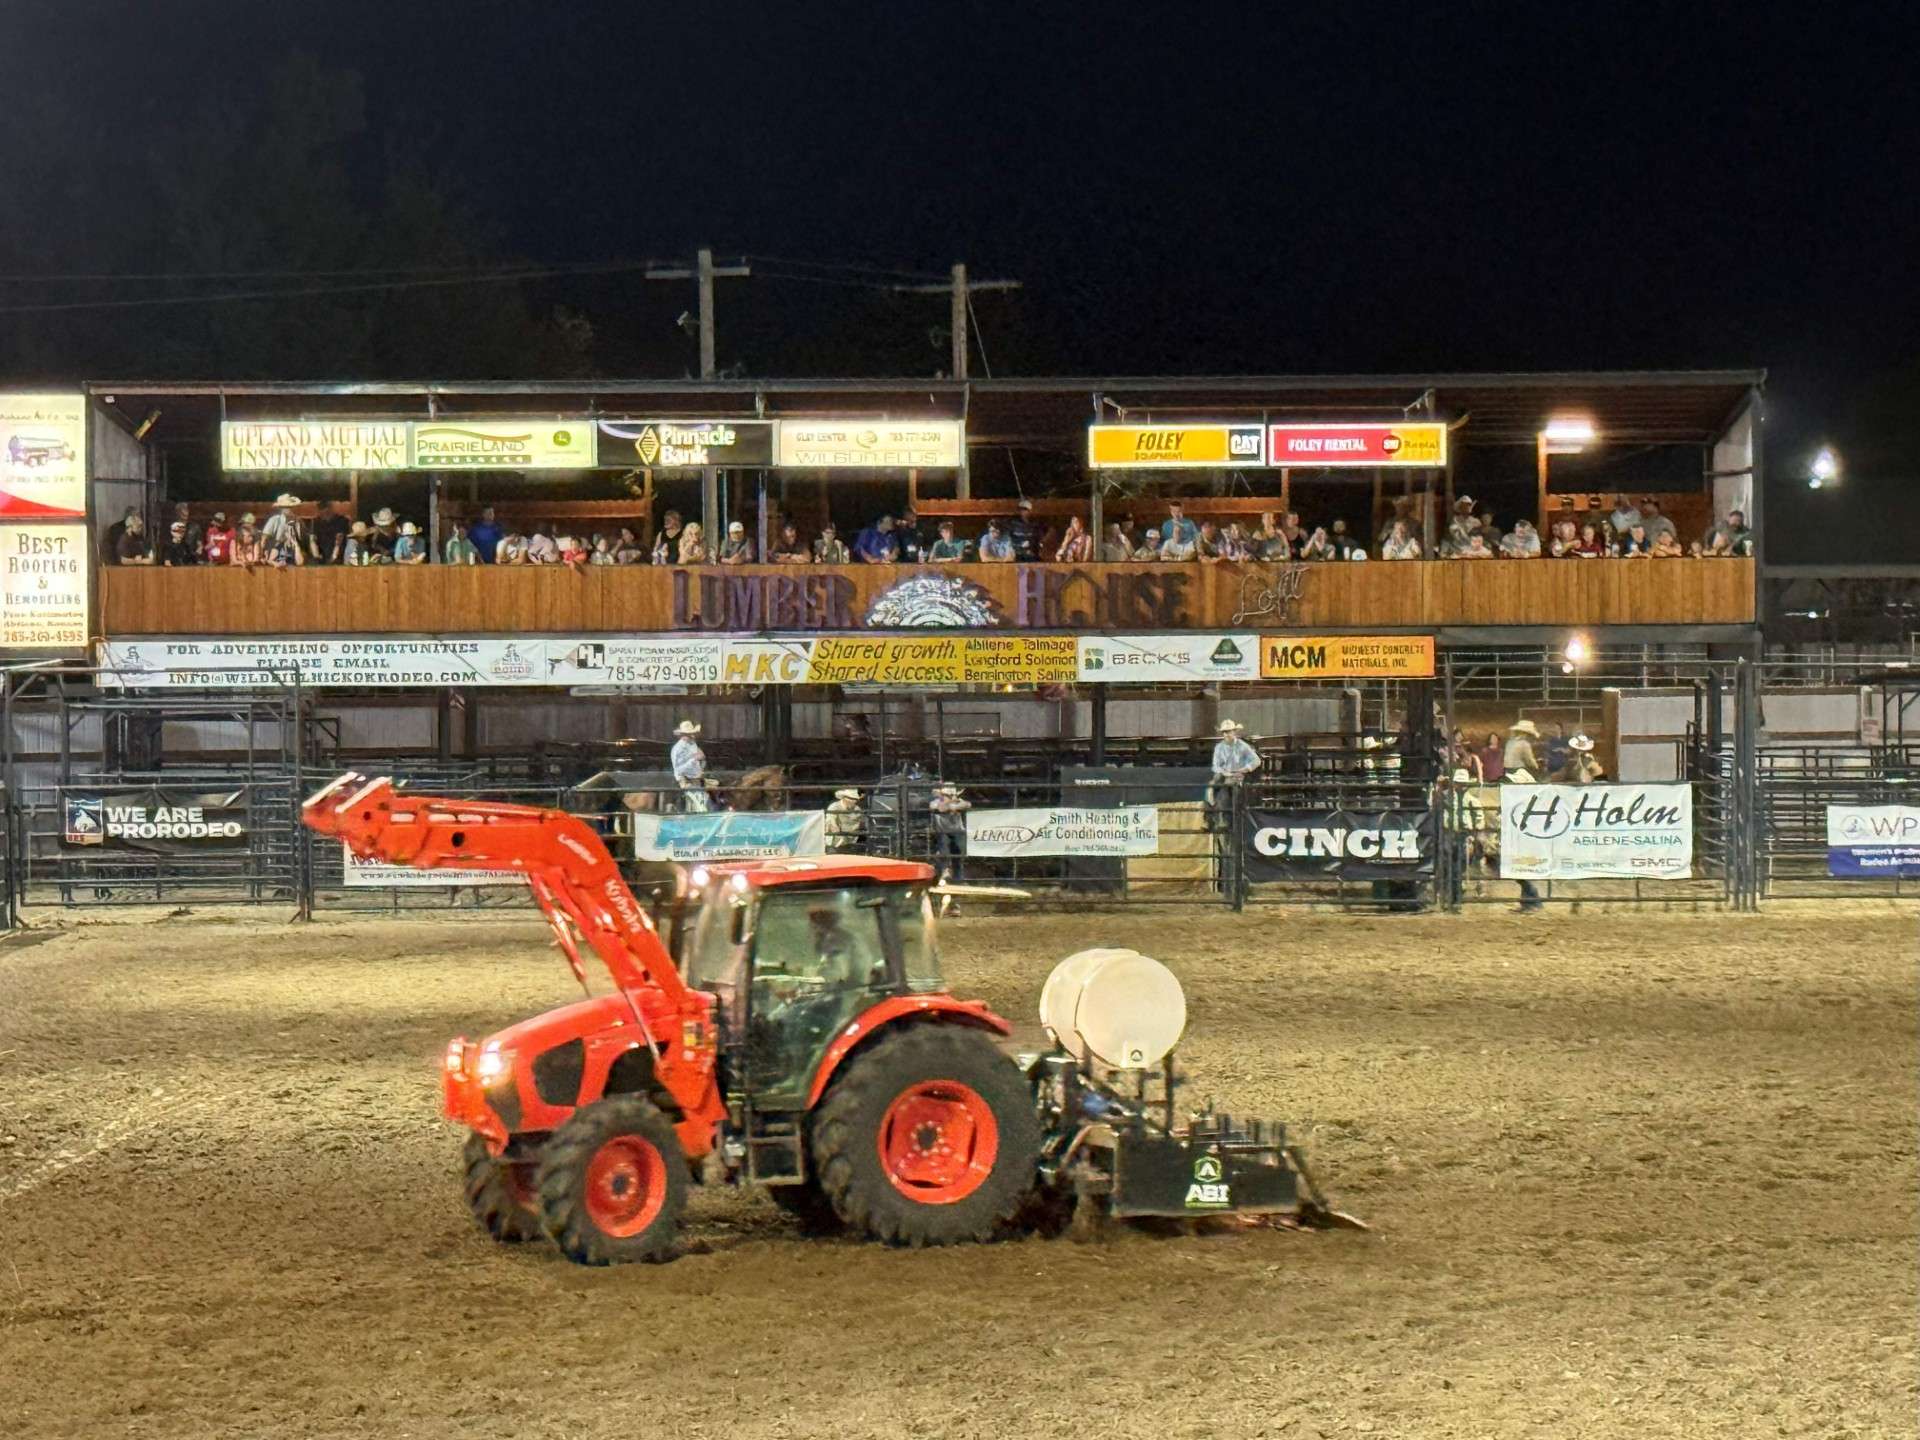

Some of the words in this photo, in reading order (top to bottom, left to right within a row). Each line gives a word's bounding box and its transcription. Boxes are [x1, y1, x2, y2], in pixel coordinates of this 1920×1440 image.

[231, 425, 311, 447] UPLAND
[321, 425, 405, 446] MUTUAL
[659, 424, 736, 446] Pinnacle
[1135, 431, 1185, 451] FOLEY
[1230, 434, 1260, 455] CAT
[1288, 438, 1323, 451] FOLEY
[1325, 438, 1368, 451] RENTAL
[239, 448, 352, 468] INSURANCE
[659, 445, 709, 466] Bank
[16, 532, 69, 555] BEST
[8, 556, 78, 574] ROOFING
[37, 576, 49, 590] &
[673, 569, 856, 628] LUMBER
[166, 644, 201, 655] FOR
[210, 643, 329, 655] ADVERTISING
[341, 642, 479, 654] OPPORTUNITIES
[817, 639, 884, 660] Shared
[890, 639, 958, 663] growth.
[965, 638, 1014, 651] Abilene
[1023, 638, 1075, 653] Talmage
[1341, 644, 1380, 655] MIDWEST
[1382, 643, 1425, 655] CONCRETE
[333, 657, 390, 668] EMAIL
[965, 653, 1022, 668] Longford
[1025, 653, 1077, 666] Solomon
[1269, 645, 1327, 669] MCM
[606, 665, 718, 681] 785-479-0819
[724, 653, 800, 681] MKC
[808, 661, 878, 681] Shared
[882, 665, 959, 681] success.
[965, 668, 1032, 683] Bennington
[1036, 667, 1077, 681] Salina
[104, 807, 147, 823] WE
[154, 806, 204, 823] ARE
[1573, 791, 1683, 828] Holm
[1049, 812, 1082, 825] Smith
[1086, 811, 1129, 830] Heating
[1132, 812, 1141, 825] &
[105, 822, 243, 839] PRORODEO
[972, 829, 1023, 842] LENNOX
[1036, 826, 1053, 839] Air
[1254, 827, 1420, 858] CINCH
[1572, 835, 1683, 847] ABILENE-SALINA
[1630, 857, 1682, 868] GMC
[1185, 1183, 1230, 1202] ABI
